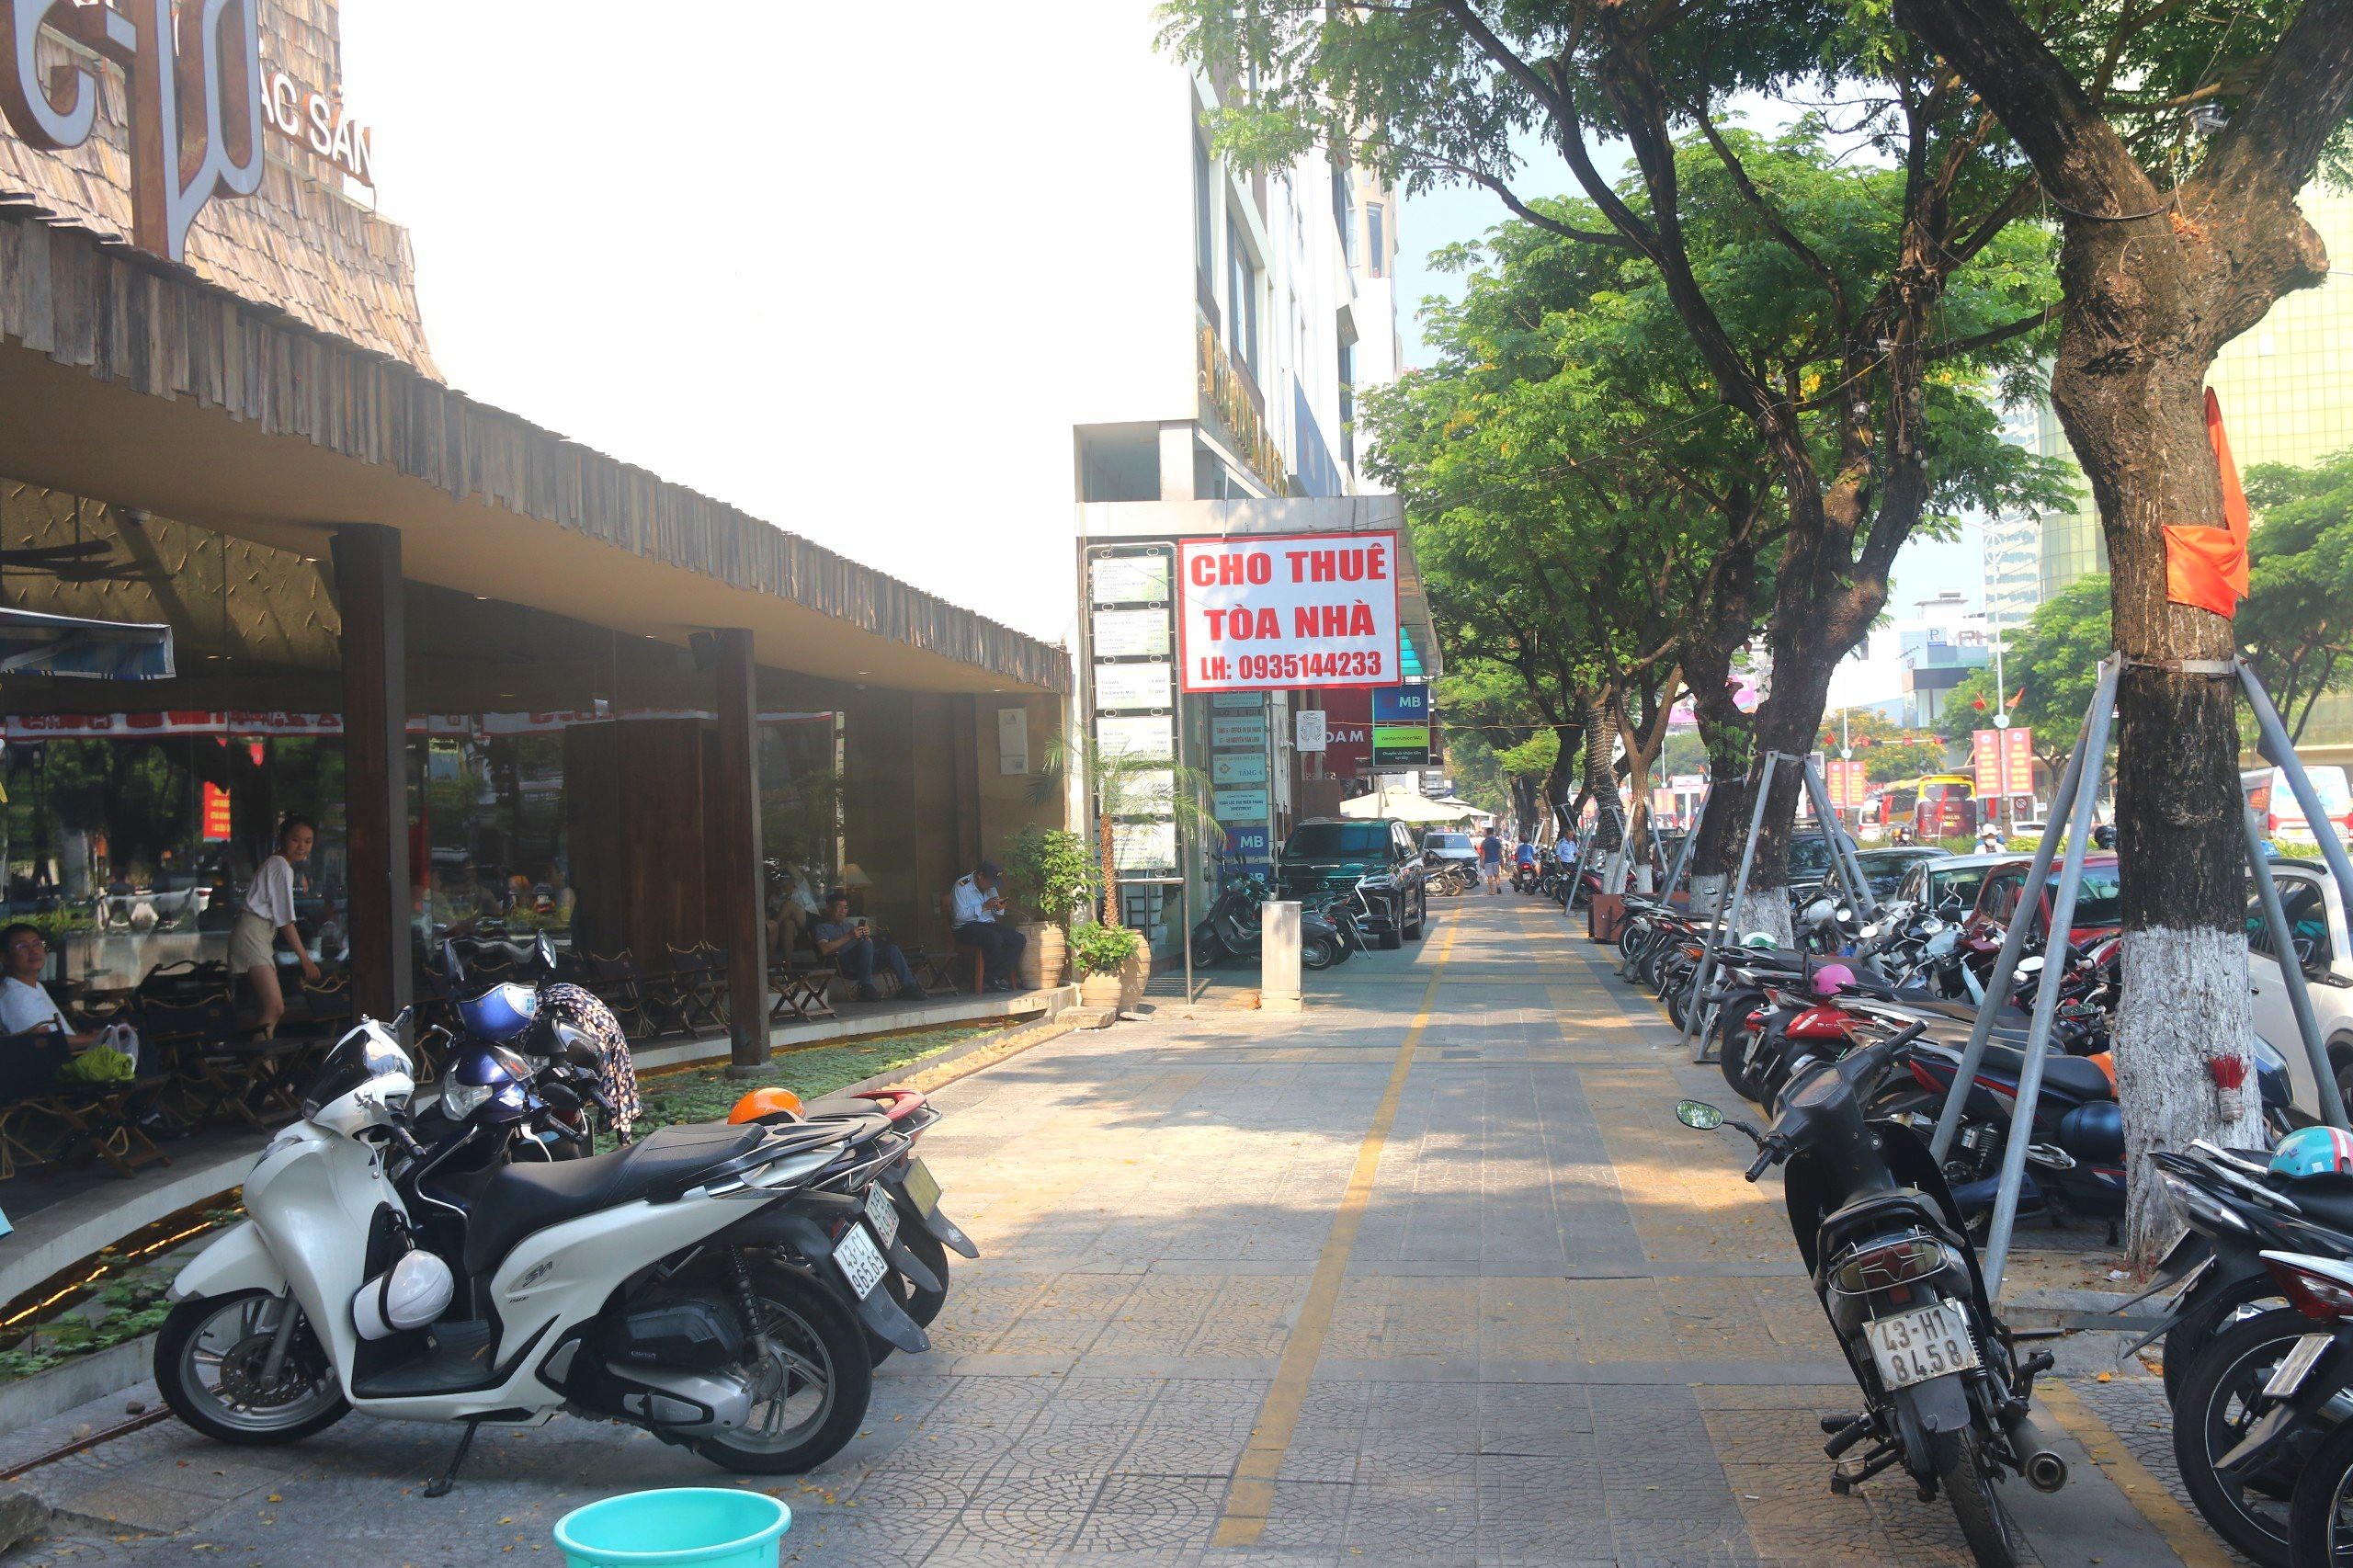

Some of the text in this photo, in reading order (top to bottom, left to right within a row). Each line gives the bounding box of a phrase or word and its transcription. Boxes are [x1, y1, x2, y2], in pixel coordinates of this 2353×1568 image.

[1191, 552, 1272, 586] CHO
[1285, 542, 1387, 583] THUÊ
[1203, 603, 1281, 641] TÒA
[1294, 599, 1376, 638] NHÀ
[1200, 651, 1381, 681] LH: 0935144233
[1399, 696, 1422, 708] MB
[1240, 835, 1264, 848] MB
[841, 1231, 869, 1268] 43-C1
[851, 1250, 885, 1295] 965.65
[1881, 1308, 1949, 1351] 43-H1
